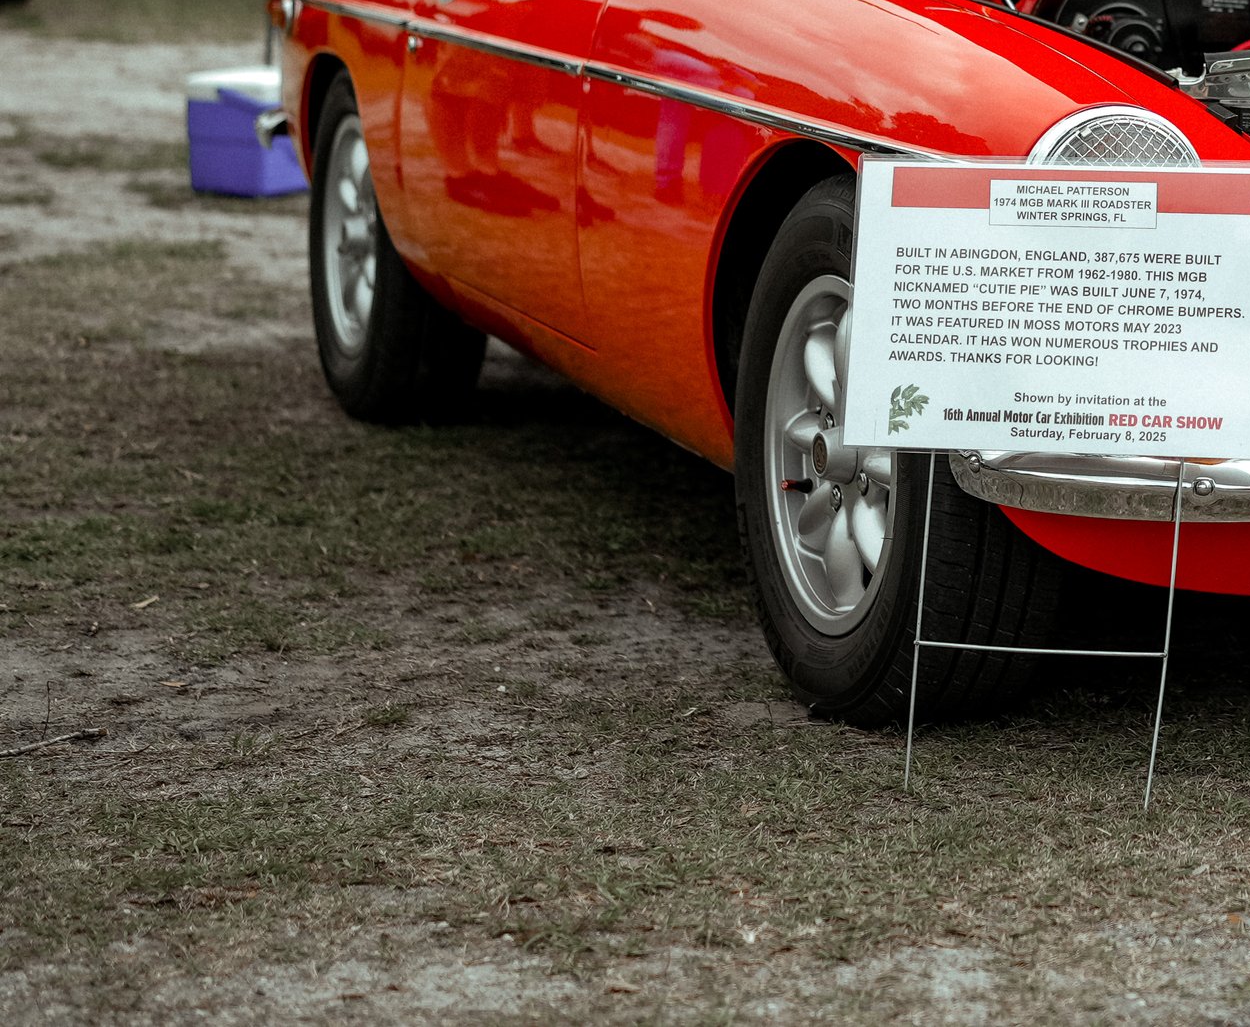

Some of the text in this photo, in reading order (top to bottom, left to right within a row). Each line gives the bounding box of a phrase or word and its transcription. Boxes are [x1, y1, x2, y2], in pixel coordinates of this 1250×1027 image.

[1015, 184, 1129, 196] MICHAEL PATTERSON
[993, 197, 1151, 210] 1974 MGB MARK III ROADSTER
[1015, 210, 1126, 223] WINTER SPRINGS, FL
[895, 246, 1222, 265] BUILT IN ABINGDON, ENGLAND, 387,675 WERE BUILT
[894, 263, 1207, 282] FOR THE U.S. MARKET FROM 1962-1980. THIS MGB
[893, 280, 969, 293] NICKNAMED
[1049, 284, 1078, 297] WAS
[1081, 285, 1119, 297] BUILT
[1121, 286, 1156, 299] JUNE
[1159, 287, 1170, 301] 7,
[1173, 288, 1205, 302] 1974,
[891, 297, 1245, 319] TWO MONTHS BEFORE THE END OF CHROME BUMPERS.
[890, 315, 1182, 334] IT WAS FEATURED IN MOSS MOTORS MAY 2023
[889, 332, 1218, 353] CALENDAR. IT HAS WON NUMEROUS TROPHIES AND
[887, 349, 1098, 367] AWARDS. THANKS FOR LOOKING!
[1013, 391, 1167, 407] Shown by invitation at the
[942, 407, 1223, 430] 16th Annual Motor Car Exhibition RED CAR SHOW
[1009, 426, 1166, 443] Saturday, February 8, 2025
